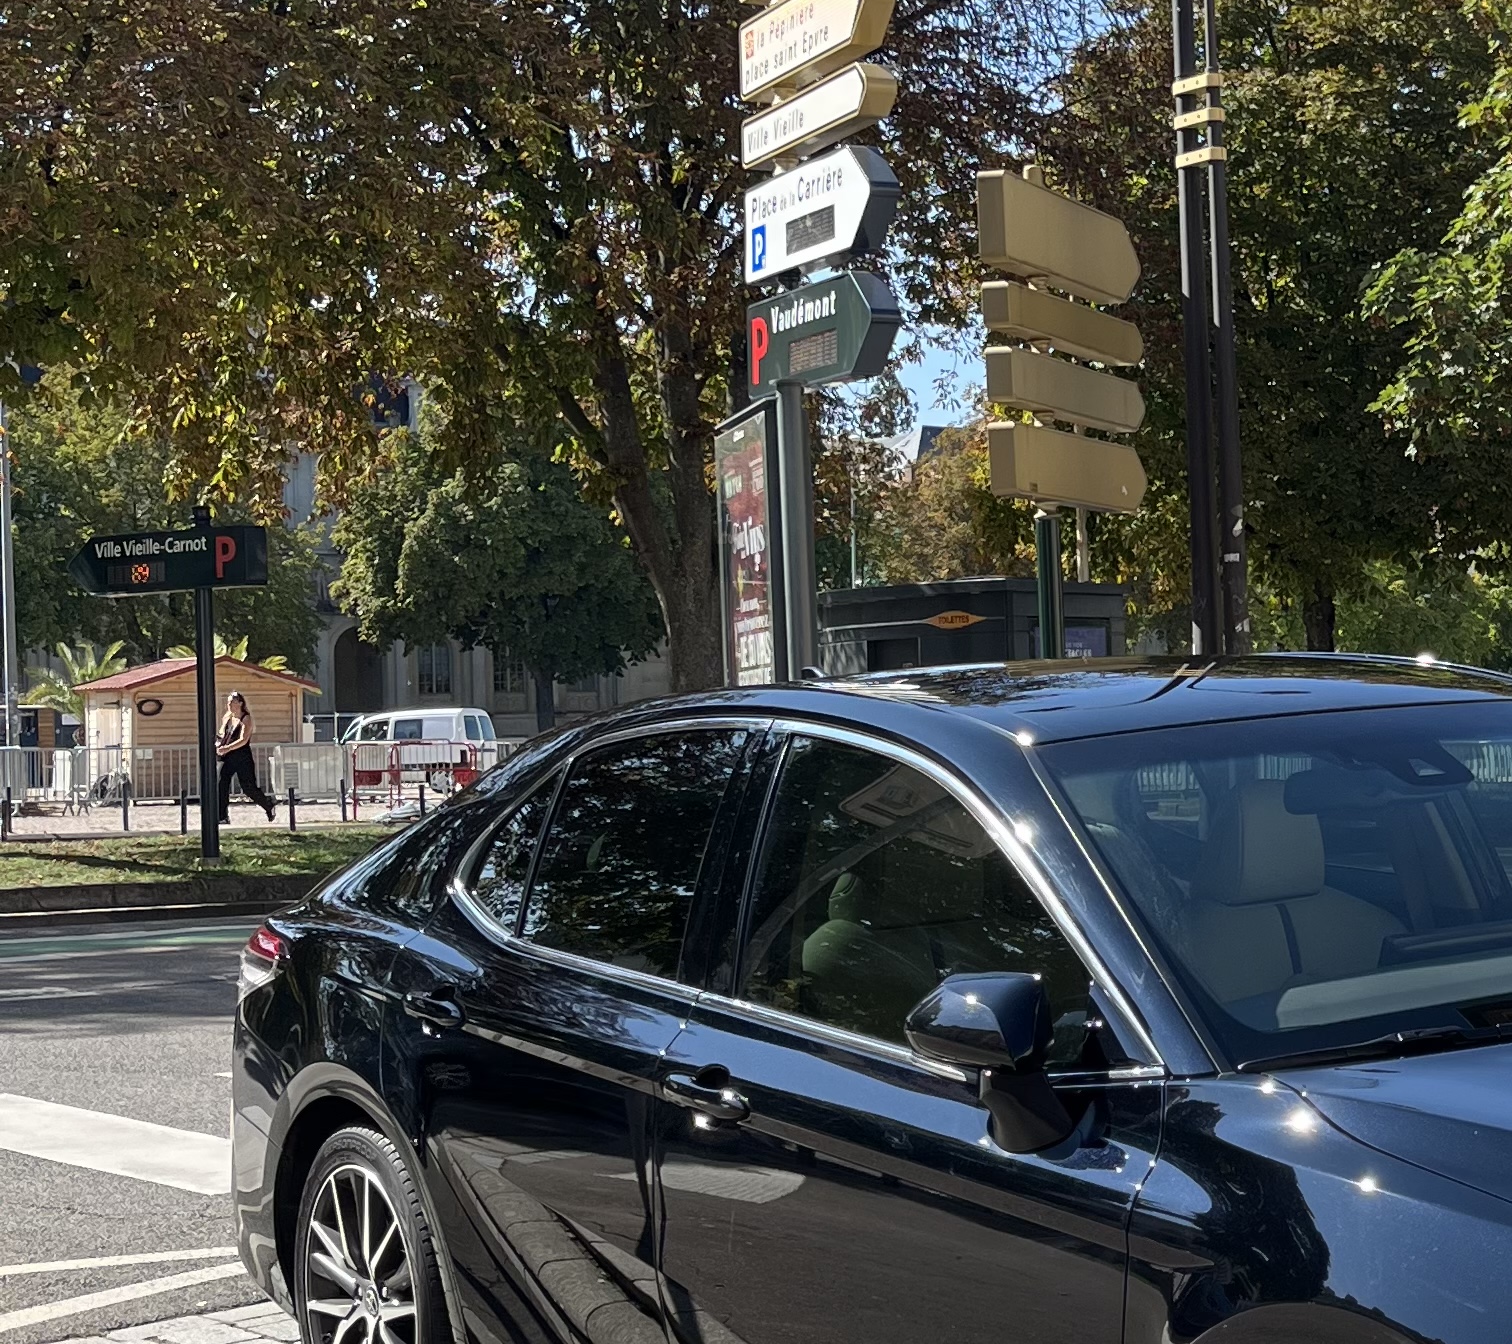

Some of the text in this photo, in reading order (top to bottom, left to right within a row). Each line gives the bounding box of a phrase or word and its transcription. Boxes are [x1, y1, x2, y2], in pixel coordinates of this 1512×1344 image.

[768, 2, 814, 44] Pépinière
[745, 59, 769, 86] place
[773, 39, 797, 69] saint
[748, 109, 804, 154] Ville Vieille
[751, 195, 777, 223] Place
[797, 166, 843, 202] Carrière
[755, 233, 764, 265] P
[770, 290, 837, 334] Vaudémont
[751, 317, 769, 385] P
[95, 536, 207, 558] Ville Vieille-Carnot
[215, 536, 236, 578] P
